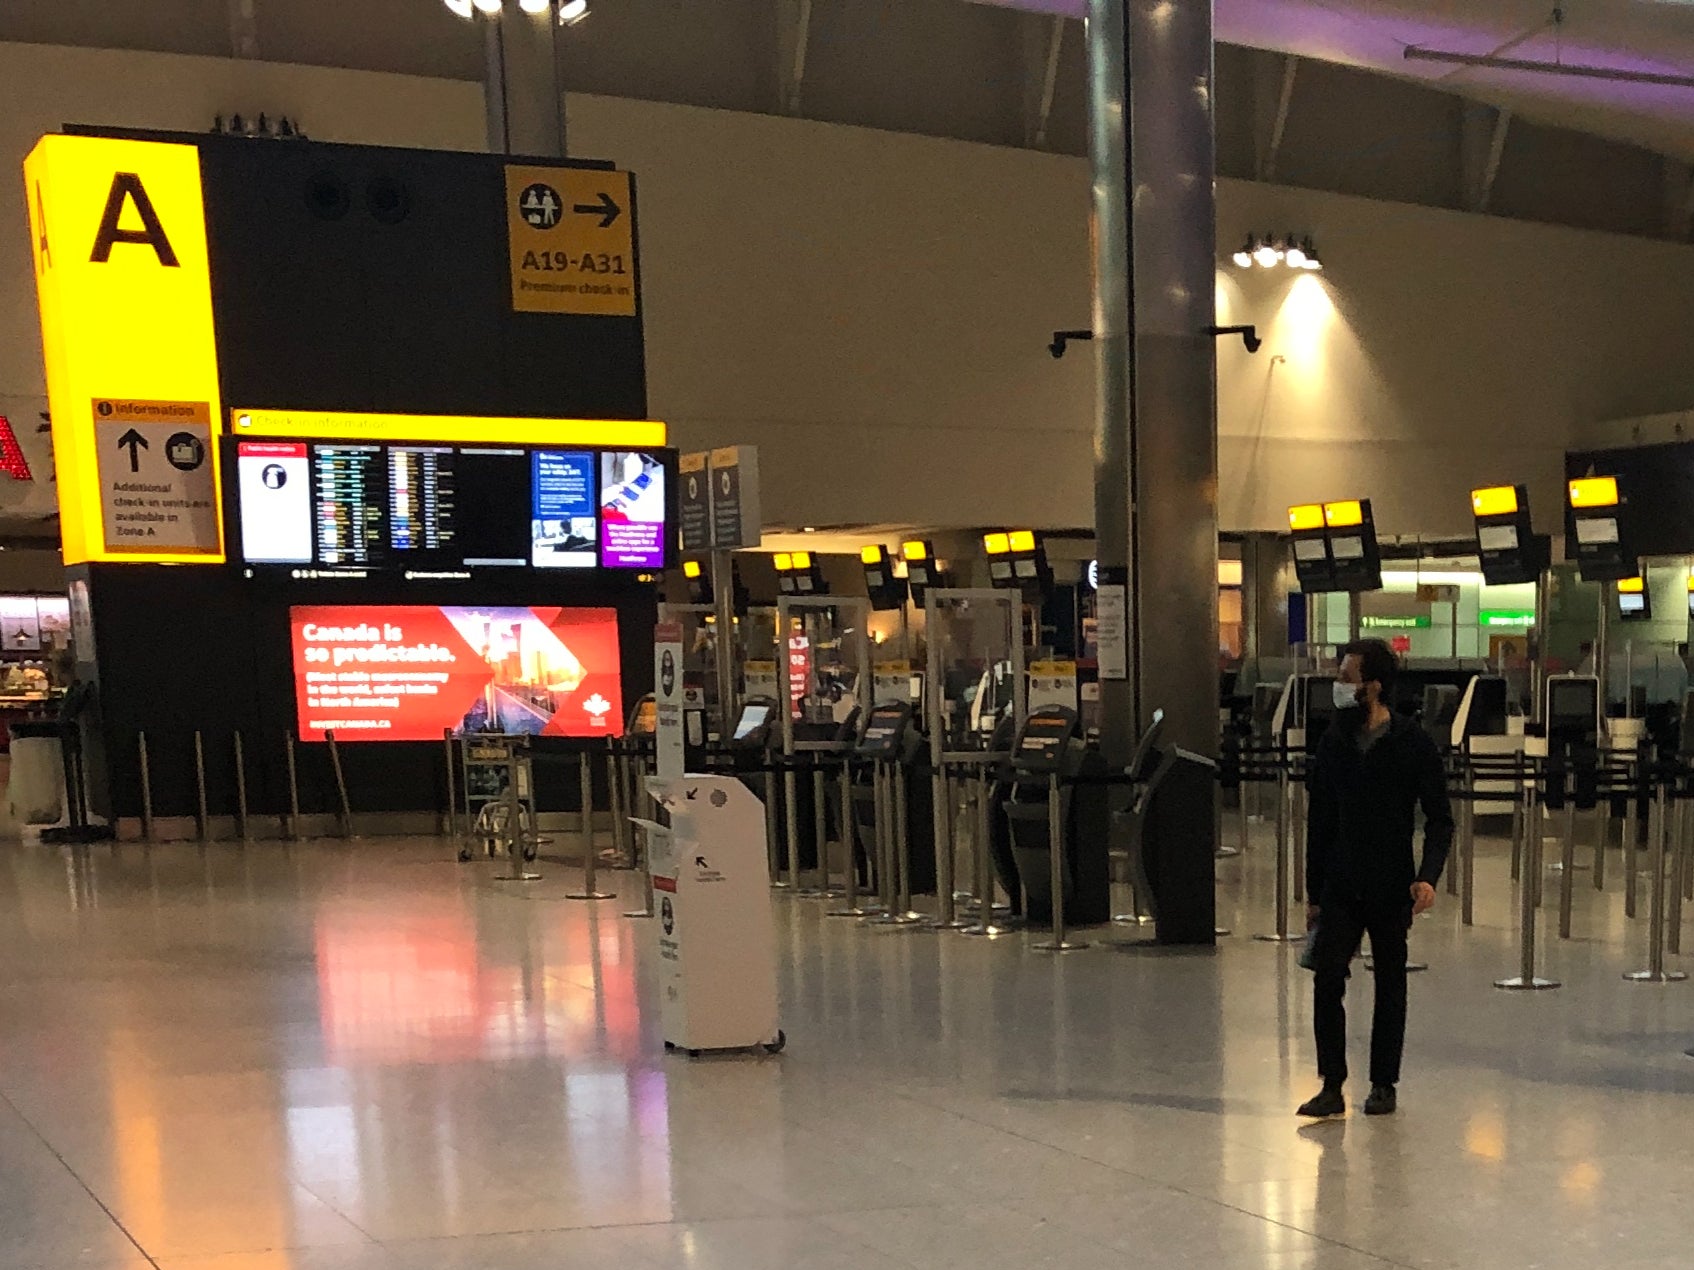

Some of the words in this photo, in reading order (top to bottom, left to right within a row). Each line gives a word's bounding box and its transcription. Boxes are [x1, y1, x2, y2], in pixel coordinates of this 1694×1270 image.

[89, 171, 181, 267] A
[521, 251, 626, 275] A19-A31
[116, 404, 194, 417] Information
[112, 482, 171, 493] Additional
[115, 511, 164, 523] available
[166, 514, 178, 523] in
[115, 526, 144, 538] Zone
[146, 527, 156, 537] A
[303, 624, 381, 642] Canada
[384, 623, 403, 642] is
[304, 647, 330, 662] so
[333, 643, 456, 666] predictable.
